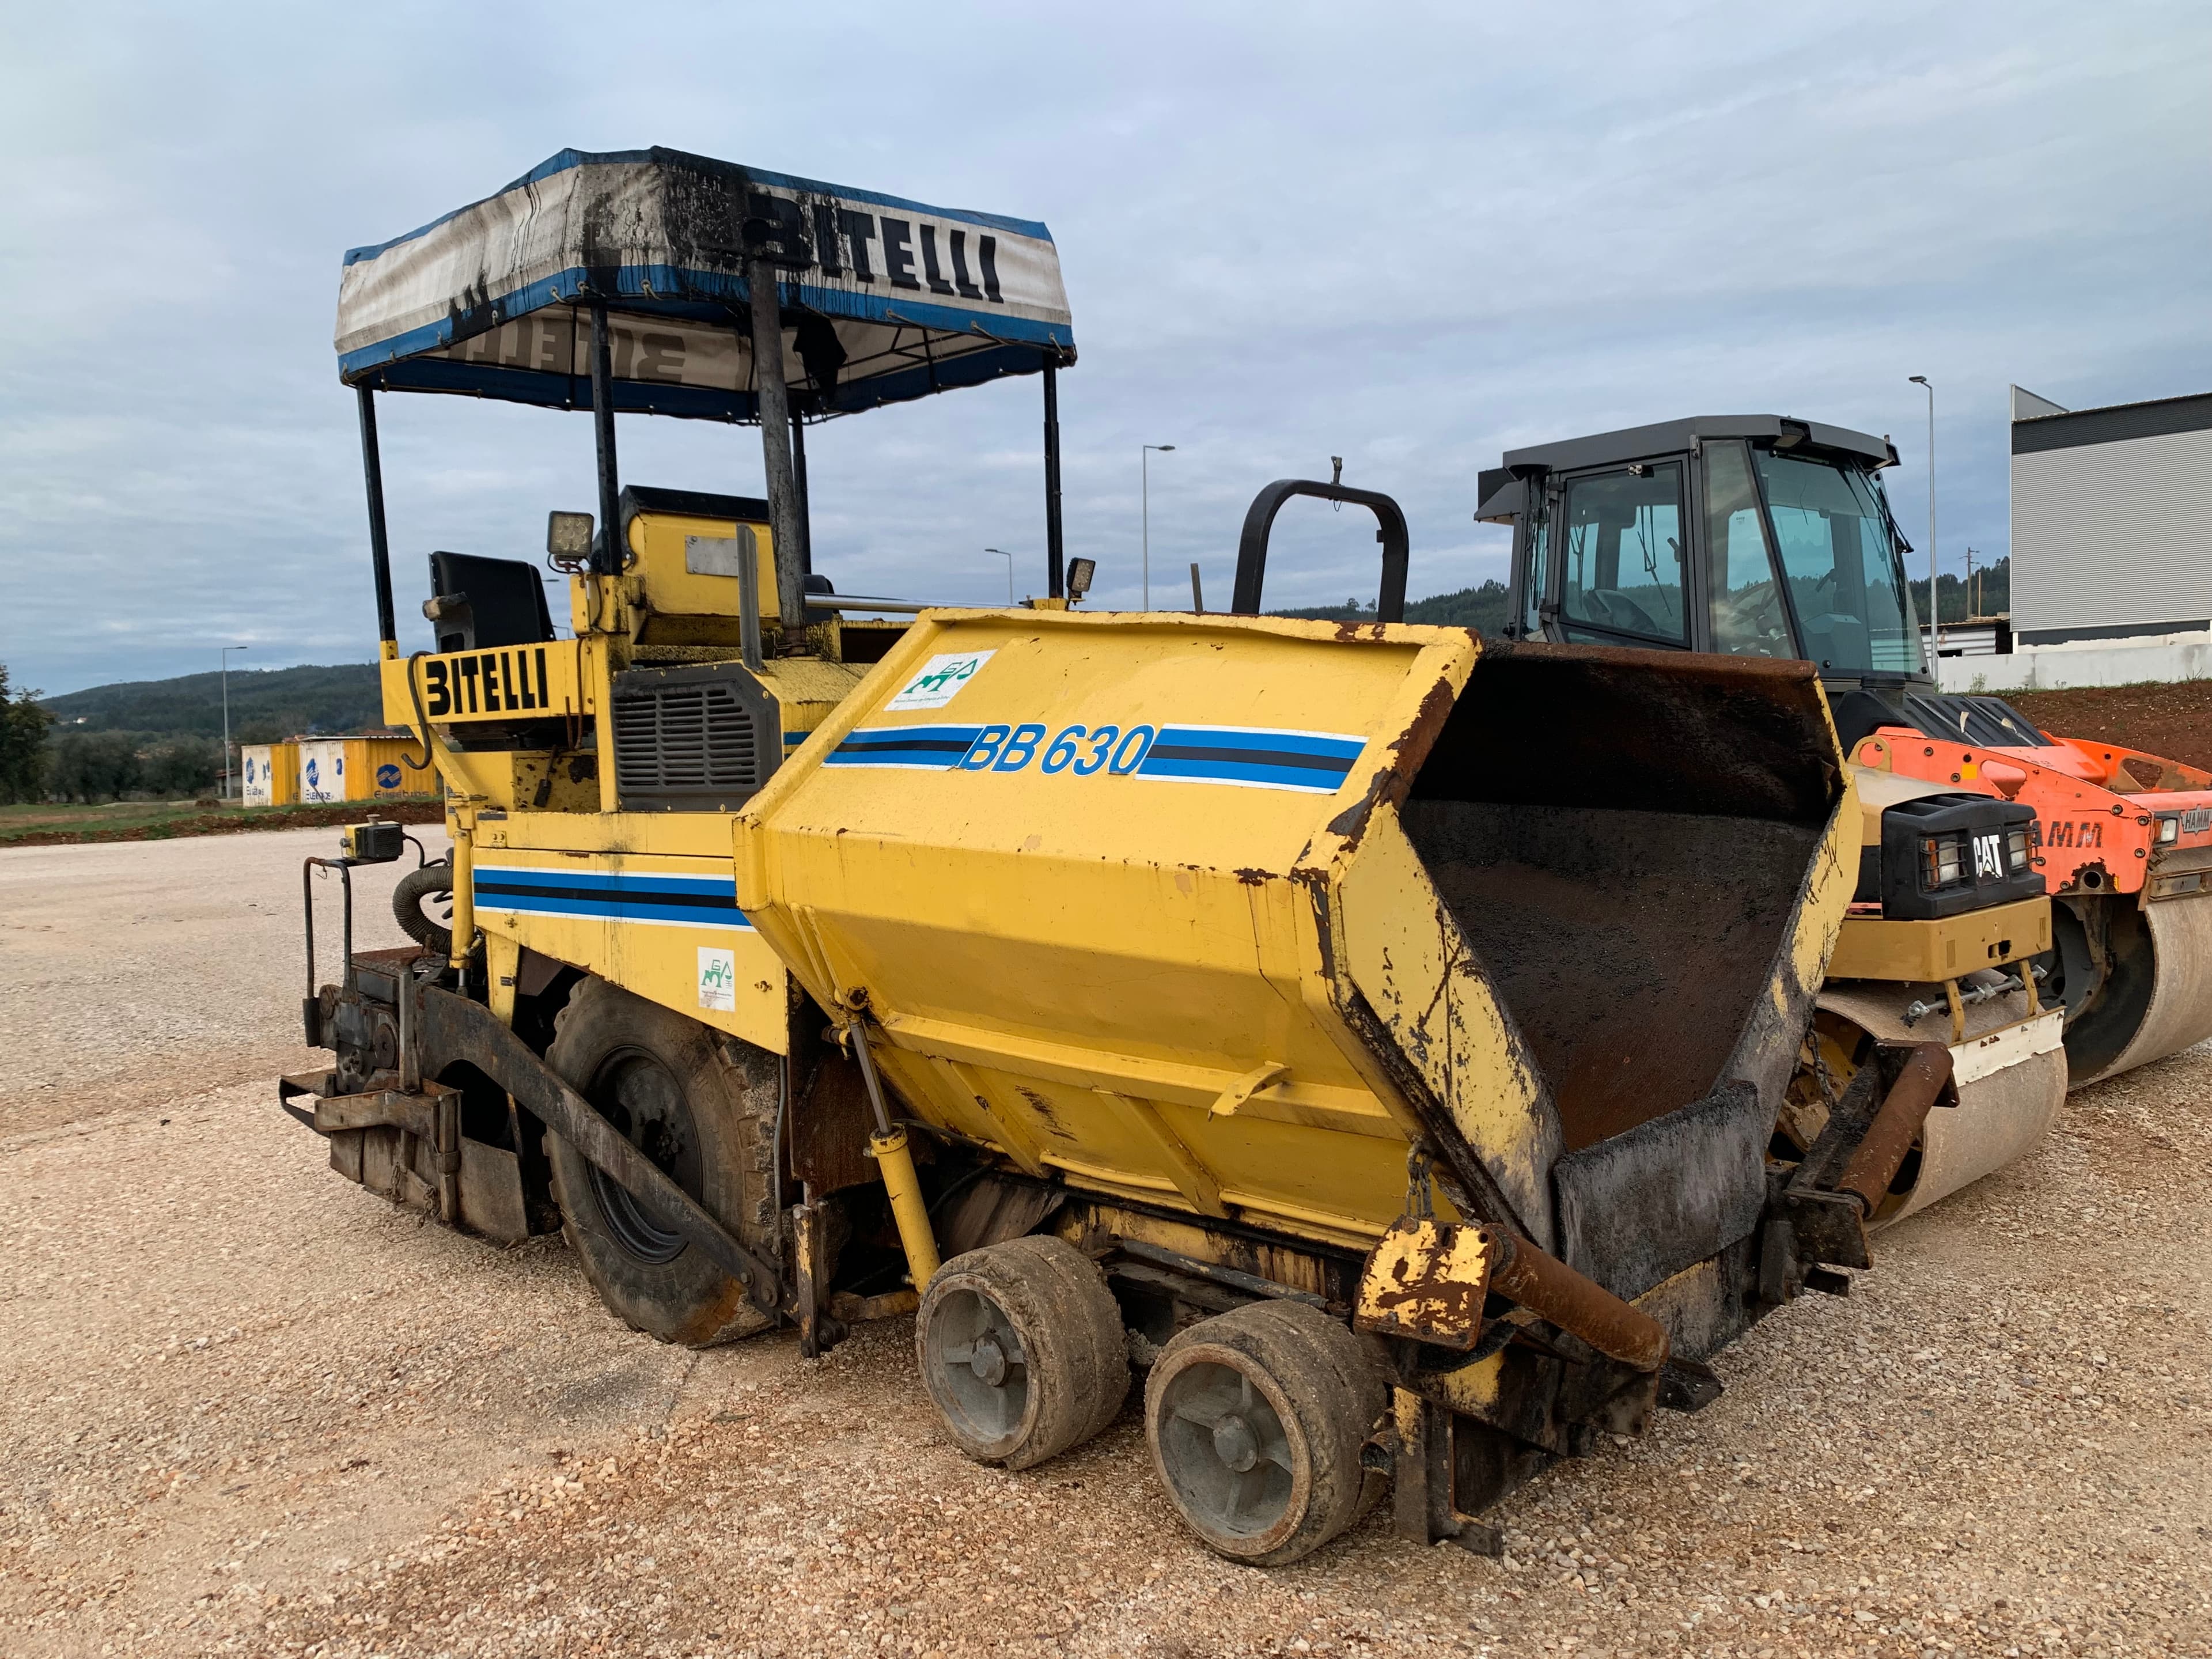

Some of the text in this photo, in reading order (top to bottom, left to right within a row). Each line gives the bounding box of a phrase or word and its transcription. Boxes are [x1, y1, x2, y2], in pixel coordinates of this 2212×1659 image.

[748, 194, 1003, 303] BITELLI
[426, 649, 549, 717] BITELLI
[959, 724, 1154, 775] BB 630
[2185, 810, 2210, 830] HAMM
[1973, 834, 2003, 878] CAT
